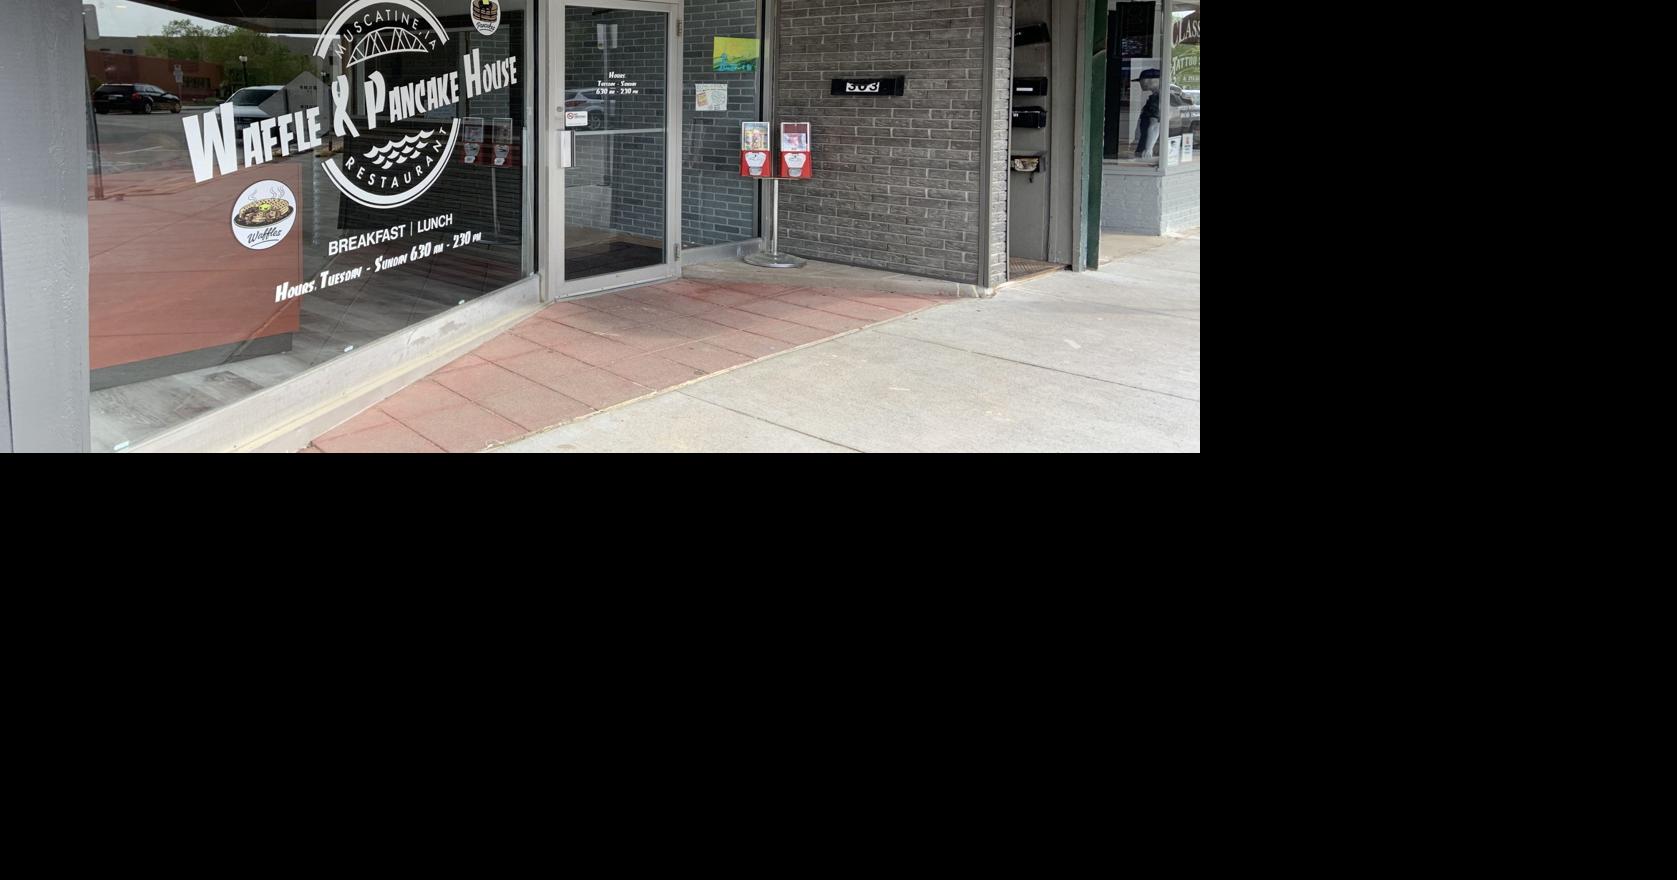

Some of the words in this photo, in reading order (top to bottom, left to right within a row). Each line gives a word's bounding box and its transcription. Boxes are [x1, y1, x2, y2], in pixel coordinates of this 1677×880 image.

[424, 31, 436, 50] IA
[345, 127, 447, 188] RESTAURANT
[247, 227, 282, 244] Waffles
[328, 224, 406, 256] BREAKFAST
[417, 213, 453, 233] LUNCH
